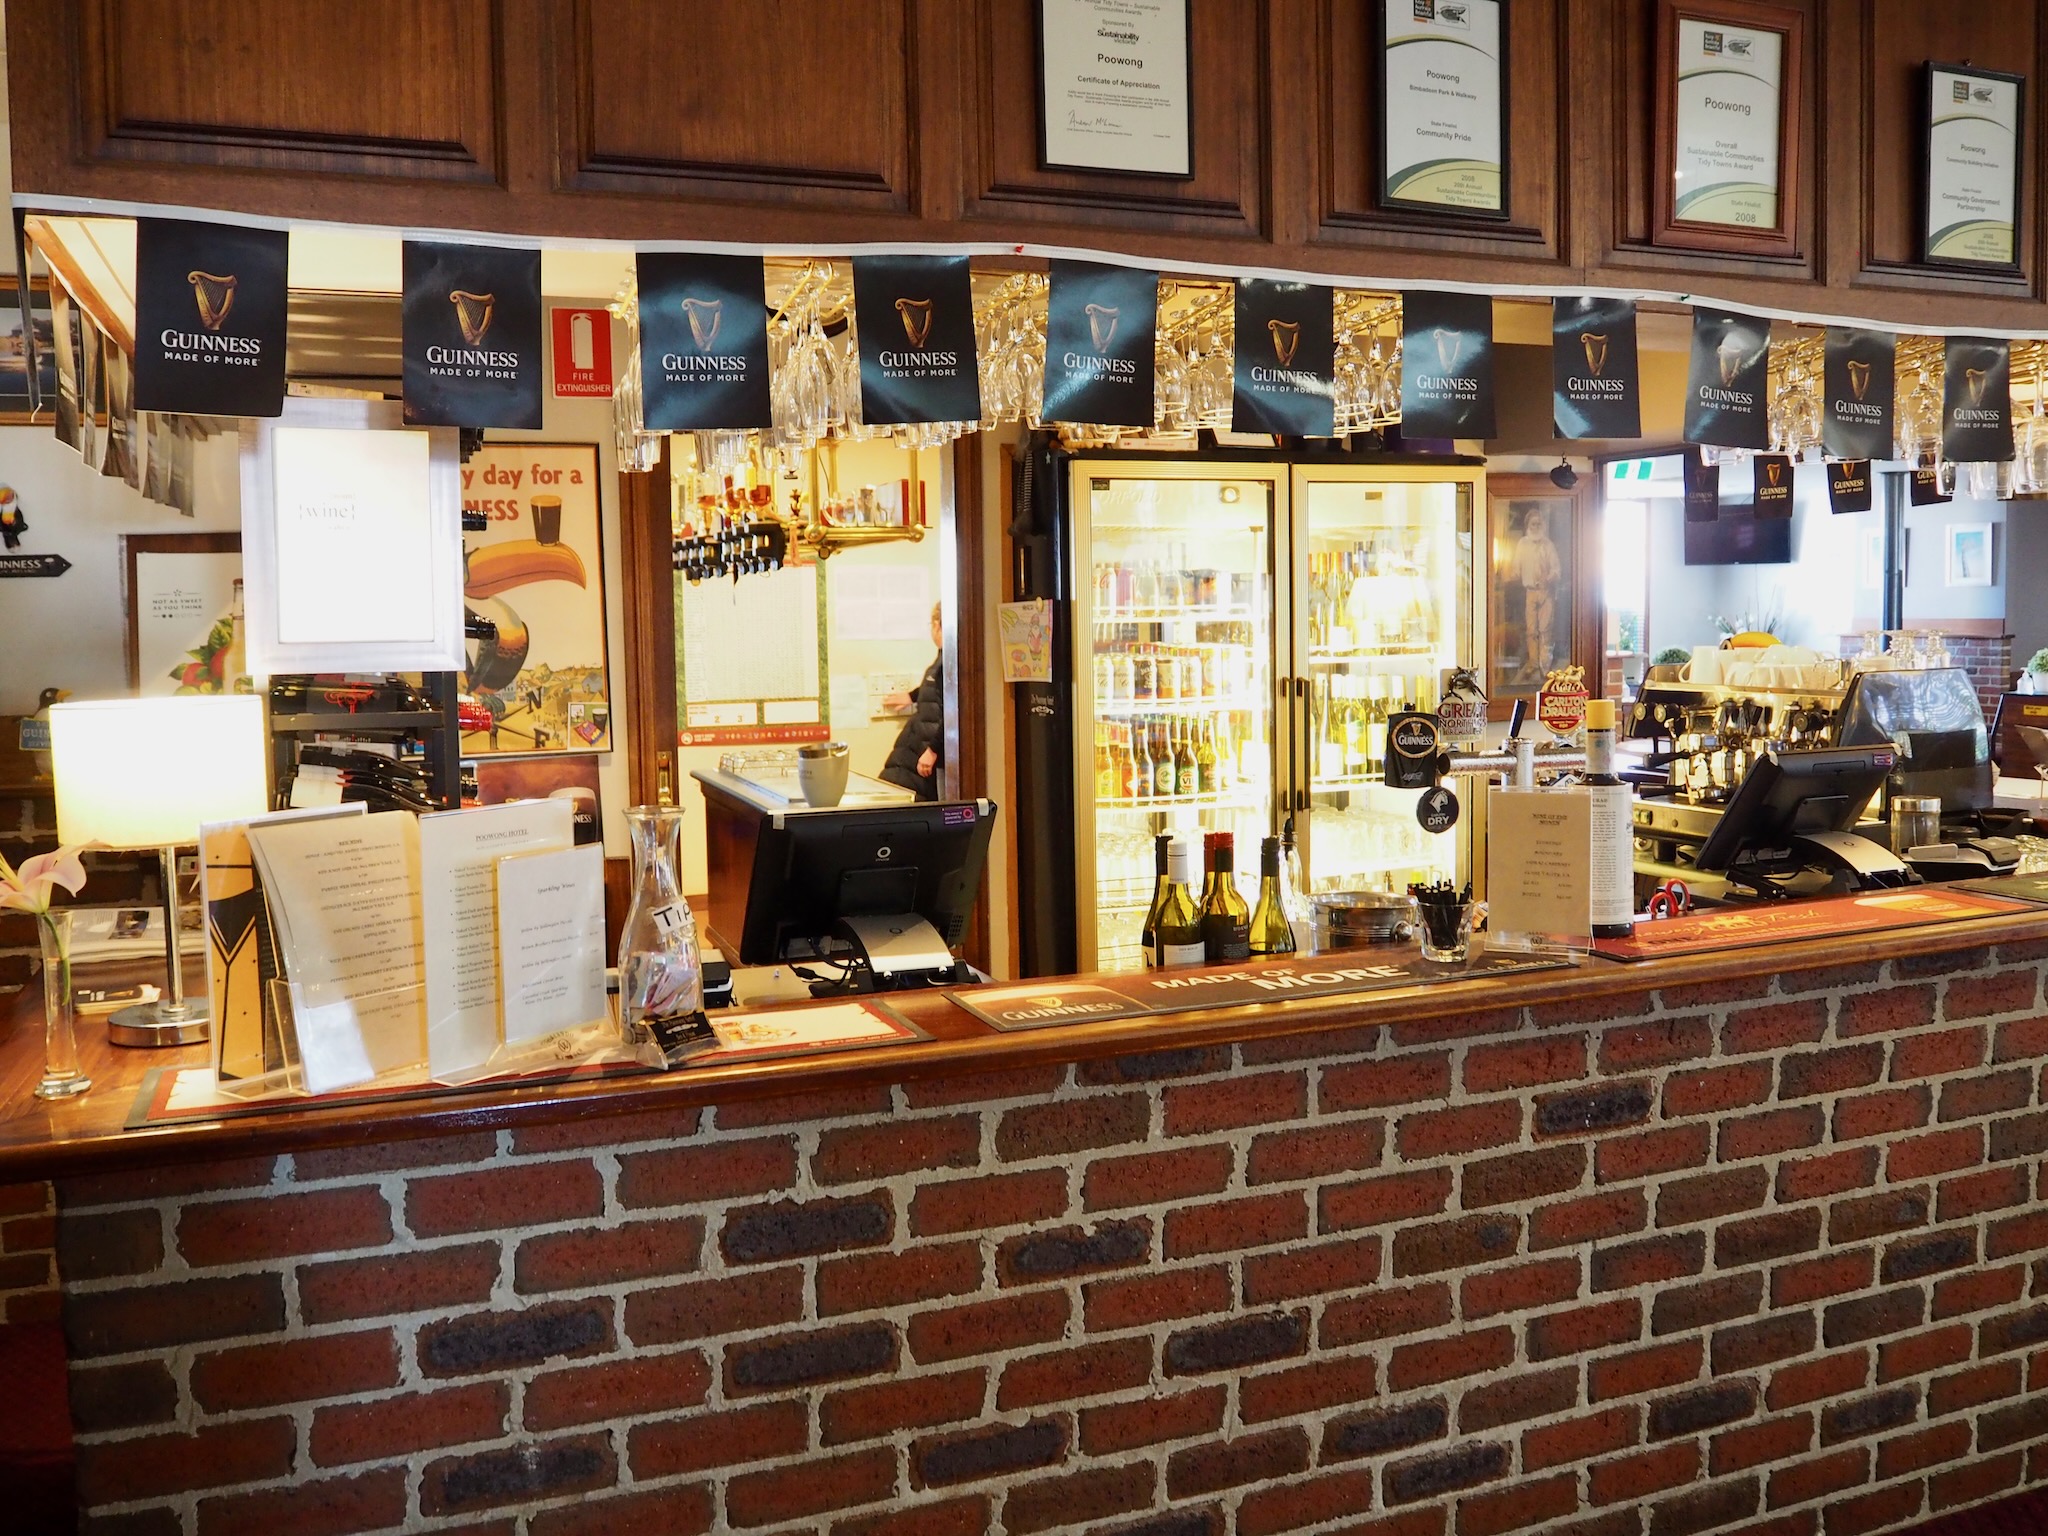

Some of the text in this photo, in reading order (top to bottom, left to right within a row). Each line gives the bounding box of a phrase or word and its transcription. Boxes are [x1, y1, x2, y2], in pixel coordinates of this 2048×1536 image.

[1097, 28, 1140, 41] Sustainability
[1097, 54, 1143, 69] Poowong
[1077, 75, 1111, 85] Certificate
[1120, 80, 1160, 90] Appreciation
[1426, 69, 1460, 84] Poowong
[1438, 88, 1450, 96] Park
[1455, 91, 1477, 100] Walkway
[1704, 97, 1751, 116] Poowong
[1416, 128, 1472, 142] Community Pride
[1715, 140, 1738, 150] Overall
[1687, 146, 1765, 163] Sustainable Communities
[1698, 157, 1754, 172] Tidy Towns Award
[1942, 192, 1970, 203] Community
[1735, 212, 1756, 224] 2008
[161, 328, 261, 354] GUINNESS
[164, 351, 258, 366] MADE OF MORE
[426, 345, 519, 367] GUINNESS
[662, 353, 746, 371] GUINNESS
[879, 350, 957, 367] GUINNESS
[1063, 351, 1136, 373] GUINNESS
[430, 367, 517, 379] MADE OF MORE
[572, 372, 594, 381] FIRE
[665, 374, 746, 382] MADE OF MORE
[883, 368, 957, 378] MADE OF MORE
[1065, 371, 1134, 384] MADE OF MORE
[1251, 366, 1318, 384] GUINNESS
[556, 383, 612, 392] EXTINGUISHER
[1253, 384, 1277, 392] MADE
[1293, 386, 1317, 395] MORE
[1416, 374, 1478, 391] GUINNESS
[1567, 376, 1624, 392] GUINNESS
[1418, 391, 1441, 399] MADE
[1443, 392, 1453, 400] OF
[1699, 385, 1753, 405] GUINNESS
[1700, 401, 1752, 413] MADE OF MORE
[1835, 399, 1882, 417] GUINNESS
[1953, 407, 2000, 421] GUINNESS
[1837, 414, 1854, 422] MADE
[1864, 417, 1881, 425] MORE
[483, 463, 523, 490] day
[531, 463, 563, 485] for
[569, 469, 584, 485] a
[1759, 485, 1788, 496] GUINNESS
[1833, 478, 1865, 490] GUINNESS
[526, 686, 542, 714] N
[1544, 695, 1588, 707] CARLTON
[1438, 702, 1487, 718] GREAT
[714, 715, 721, 724] 2
[737, 715, 743, 723] 3
[1397, 734, 1434, 746] GUINNESS
[1427, 816, 1450, 826] DRY
[475, 828, 529, 842] POOWONG HOTEL
[537, 885, 560, 895] Sparkling
[653, 902, 690, 927] TIP
[1151, 968, 1296, 990] MADE OF
[1249, 964, 1410, 990] MORE
[1002, 1002, 1124, 1020] GUINNESS
